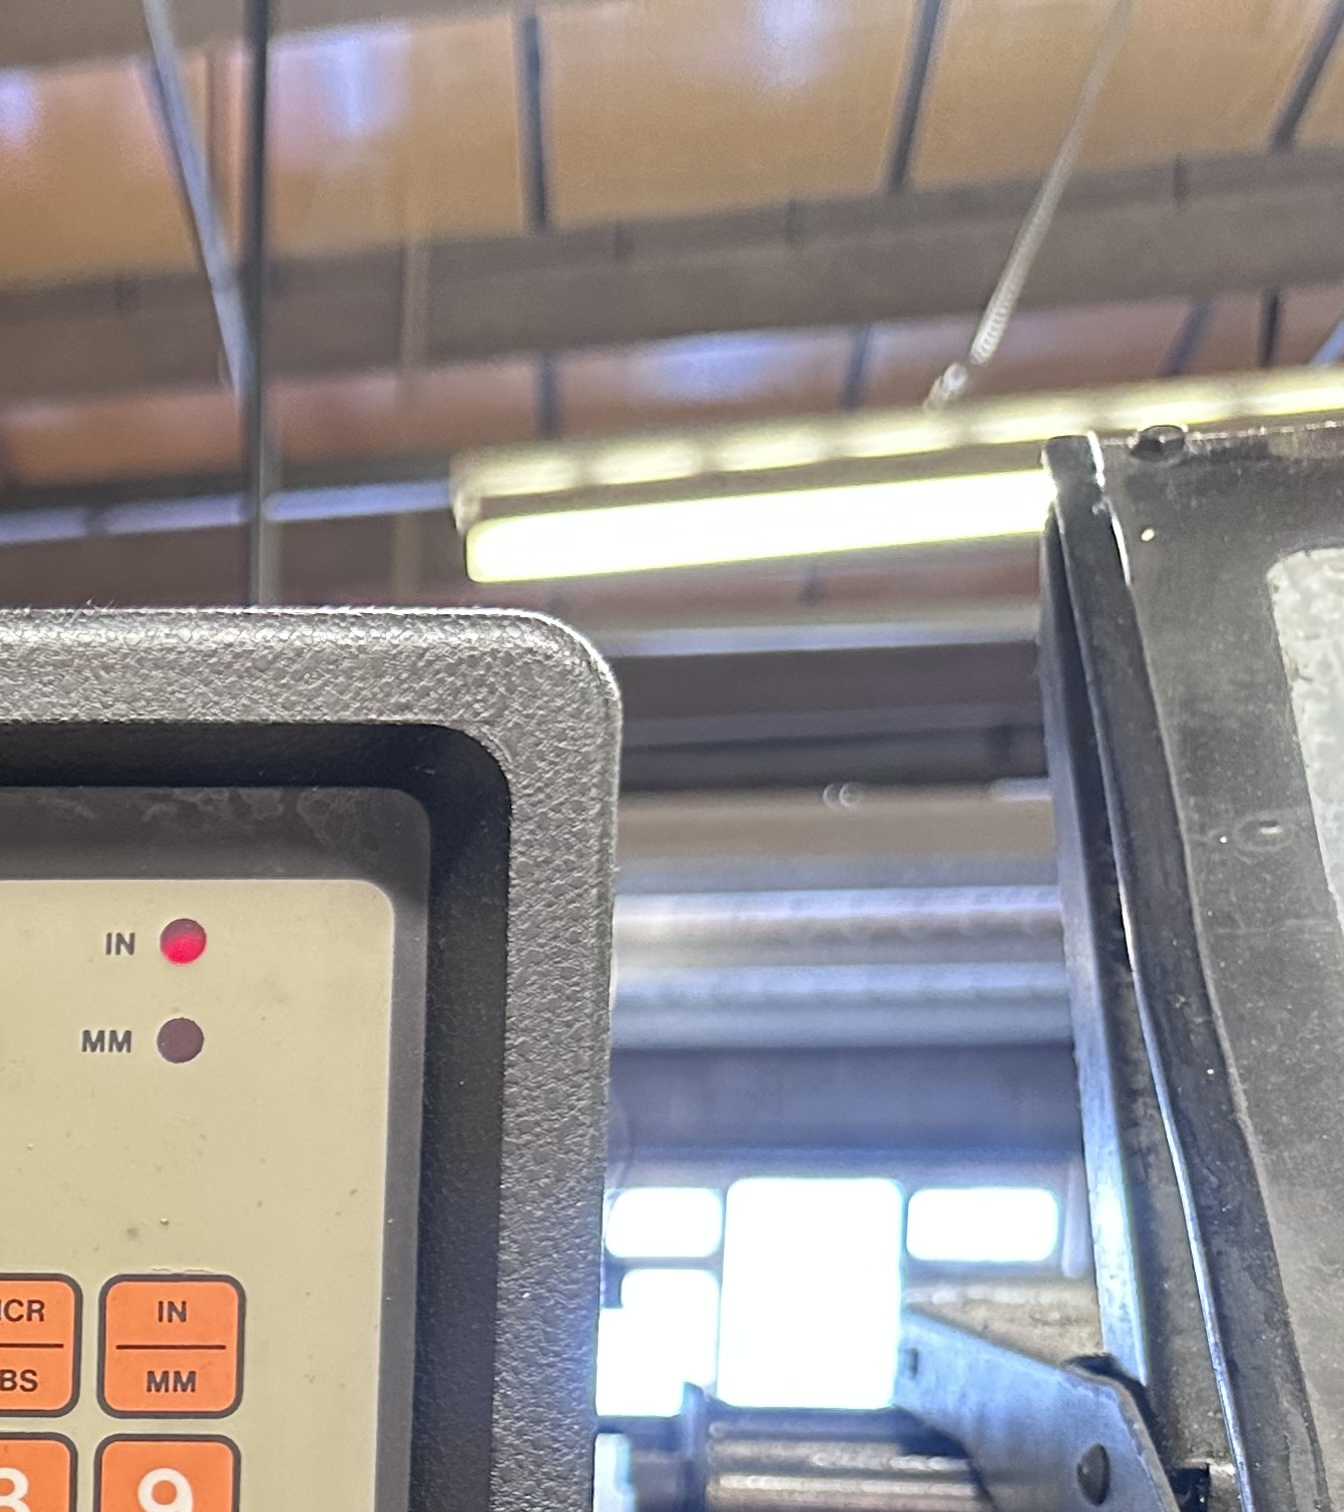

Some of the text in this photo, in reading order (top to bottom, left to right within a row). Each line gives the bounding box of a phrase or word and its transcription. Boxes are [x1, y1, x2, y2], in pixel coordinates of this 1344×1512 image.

[104, 931, 137, 957] IN
[80, 1028, 134, 1055] MM
[156, 1299, 188, 1324] IN
[145, 1369, 198, 1394] MM
